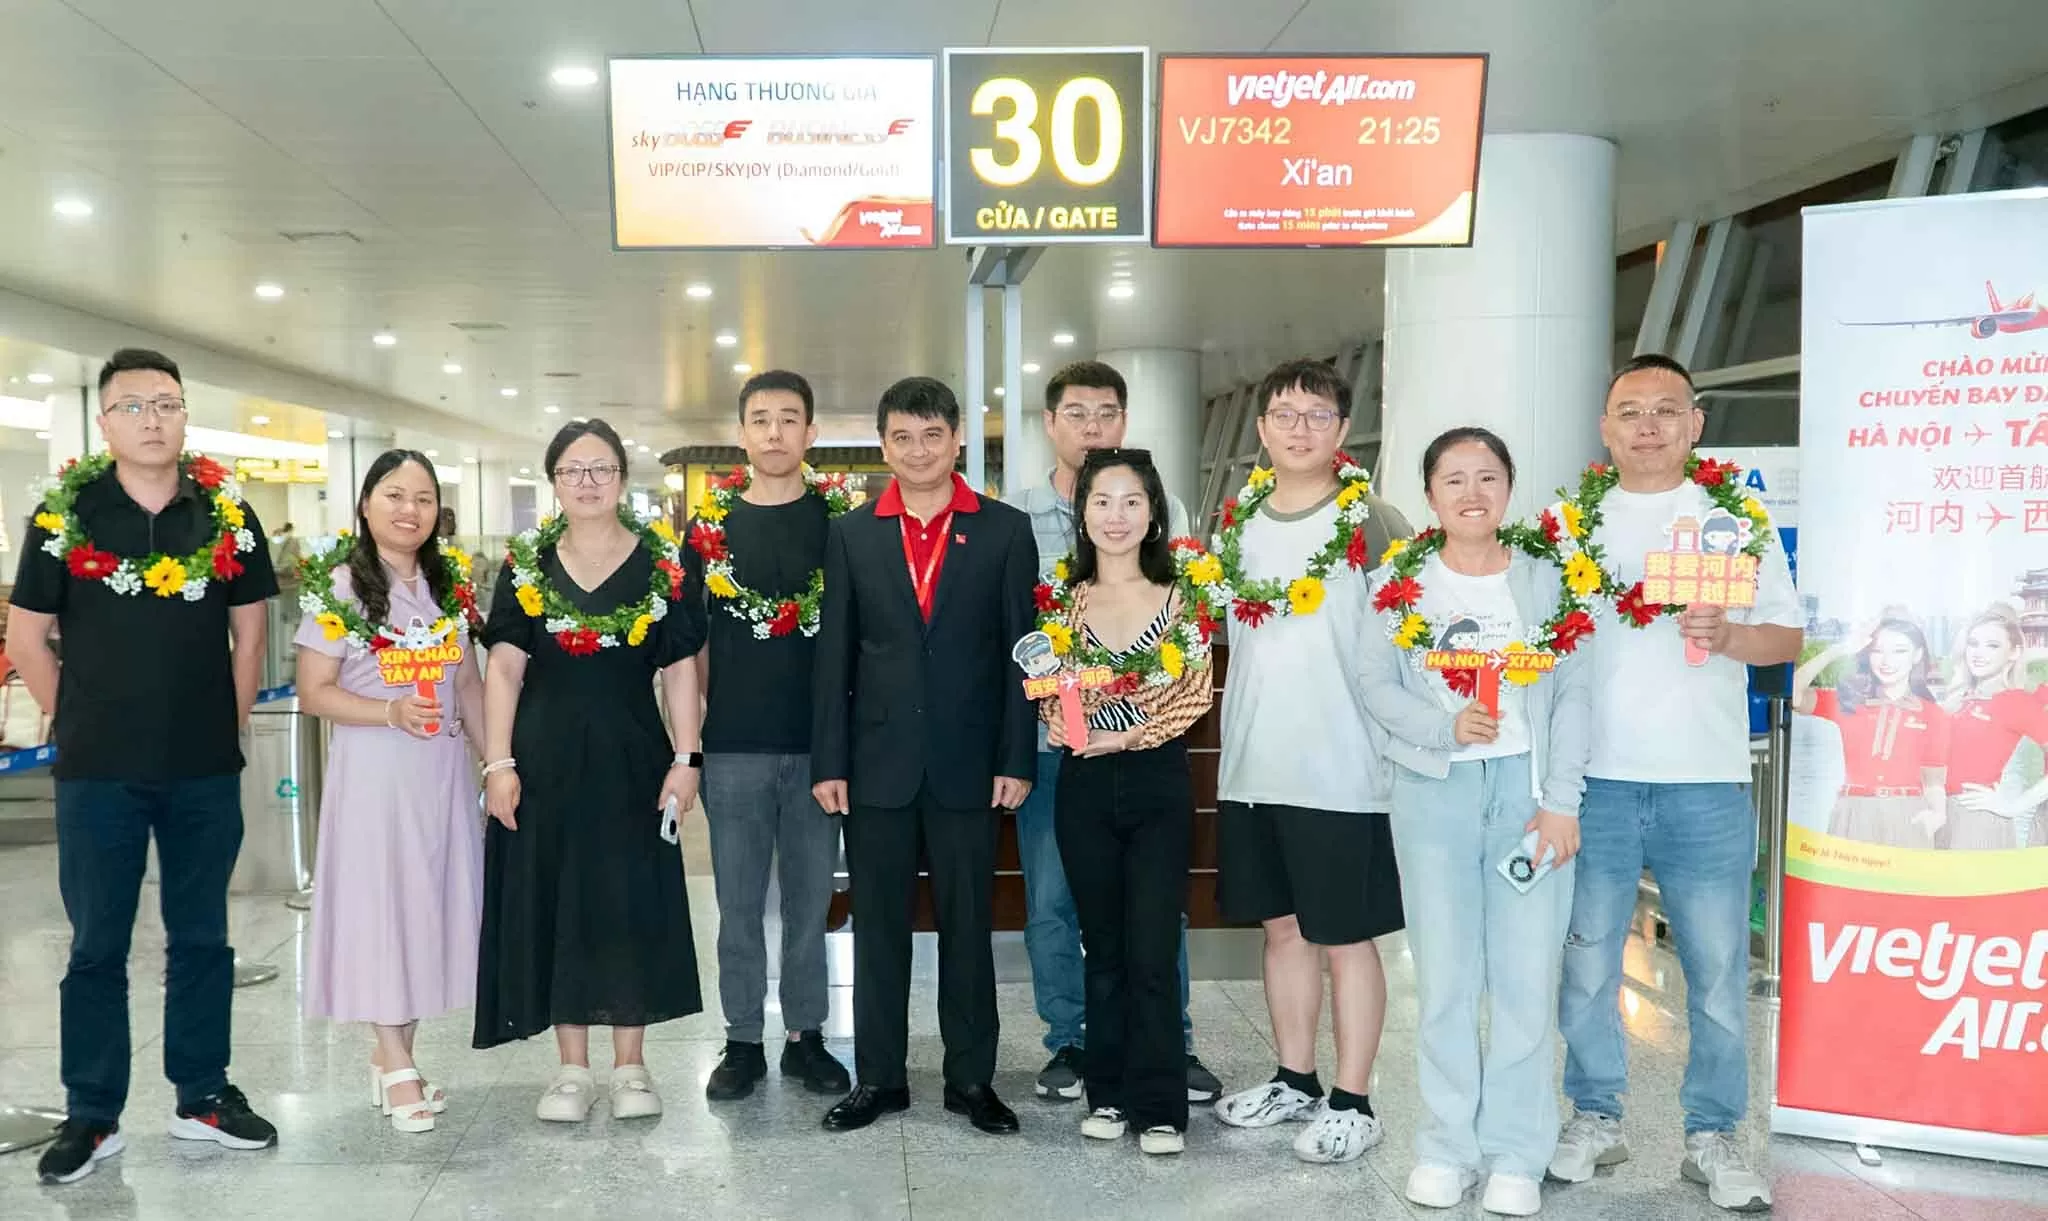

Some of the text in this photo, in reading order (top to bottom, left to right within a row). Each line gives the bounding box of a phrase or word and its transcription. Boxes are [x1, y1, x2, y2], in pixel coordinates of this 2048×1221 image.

[677, 81, 738, 107] HẠNG
[970, 76, 1123, 187] 30
[1178, 116, 1441, 145] VJ7342 21:25
[1280, 157, 1353, 186] Xi'an
[976, 200, 1030, 230] CỬA
[1049, 206, 1118, 230] GATE
[1922, 354, 1994, 378] CHÀO
[1858, 379, 1961, 408] CHUYẾN
[1967, 385, 2019, 405] BAY
[1848, 420, 1889, 448] HÀ
[1897, 421, 1953, 452] NỘI
[1885, 499, 1964, 535] 河内
[380, 649, 411, 665] XIN
[419, 665, 443, 681] AN
